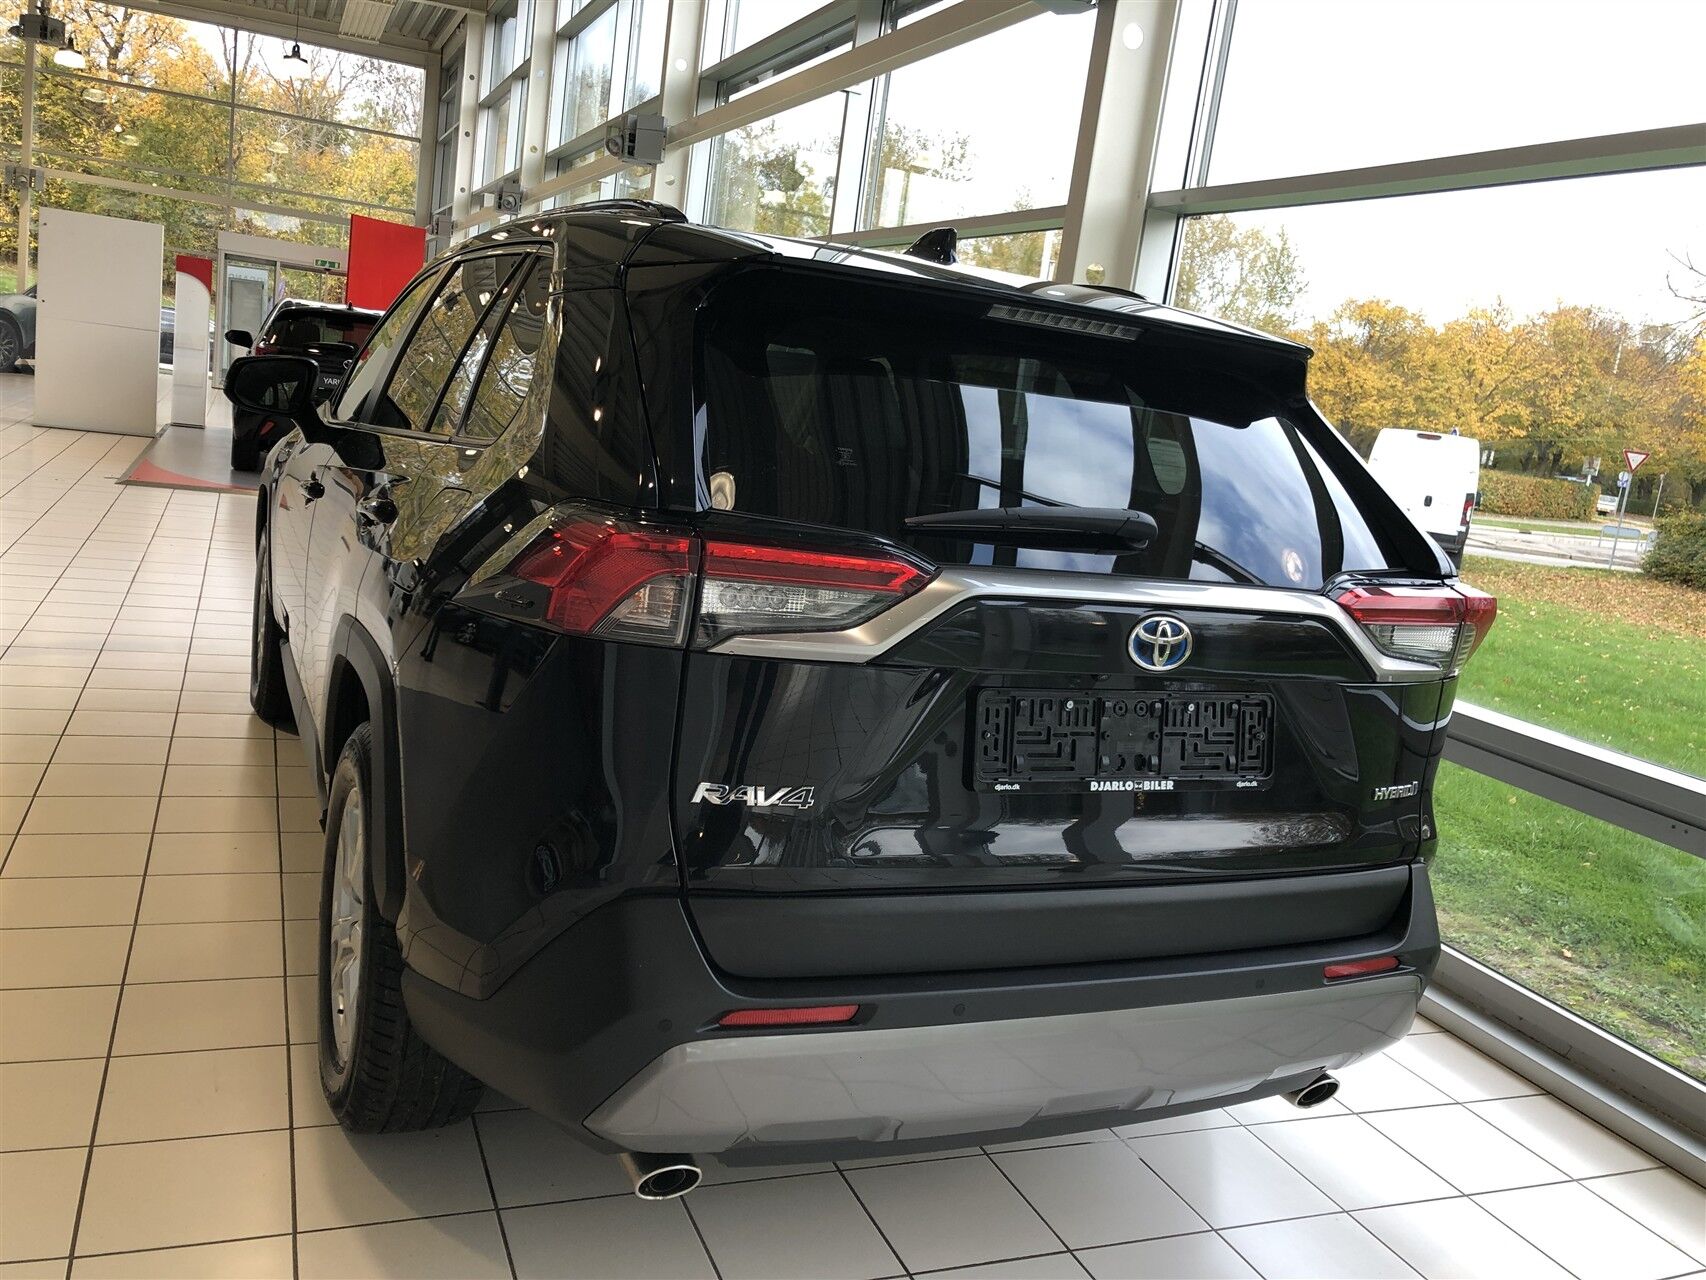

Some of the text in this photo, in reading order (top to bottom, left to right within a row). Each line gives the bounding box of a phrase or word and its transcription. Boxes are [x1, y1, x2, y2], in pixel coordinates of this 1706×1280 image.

[994, 783, 1020, 791] djarlo.dk
[1090, 780, 1174, 791] DJARLO BILER
[1374, 781, 1418, 800] HYBRID
[690, 782, 815, 809] RAV4
